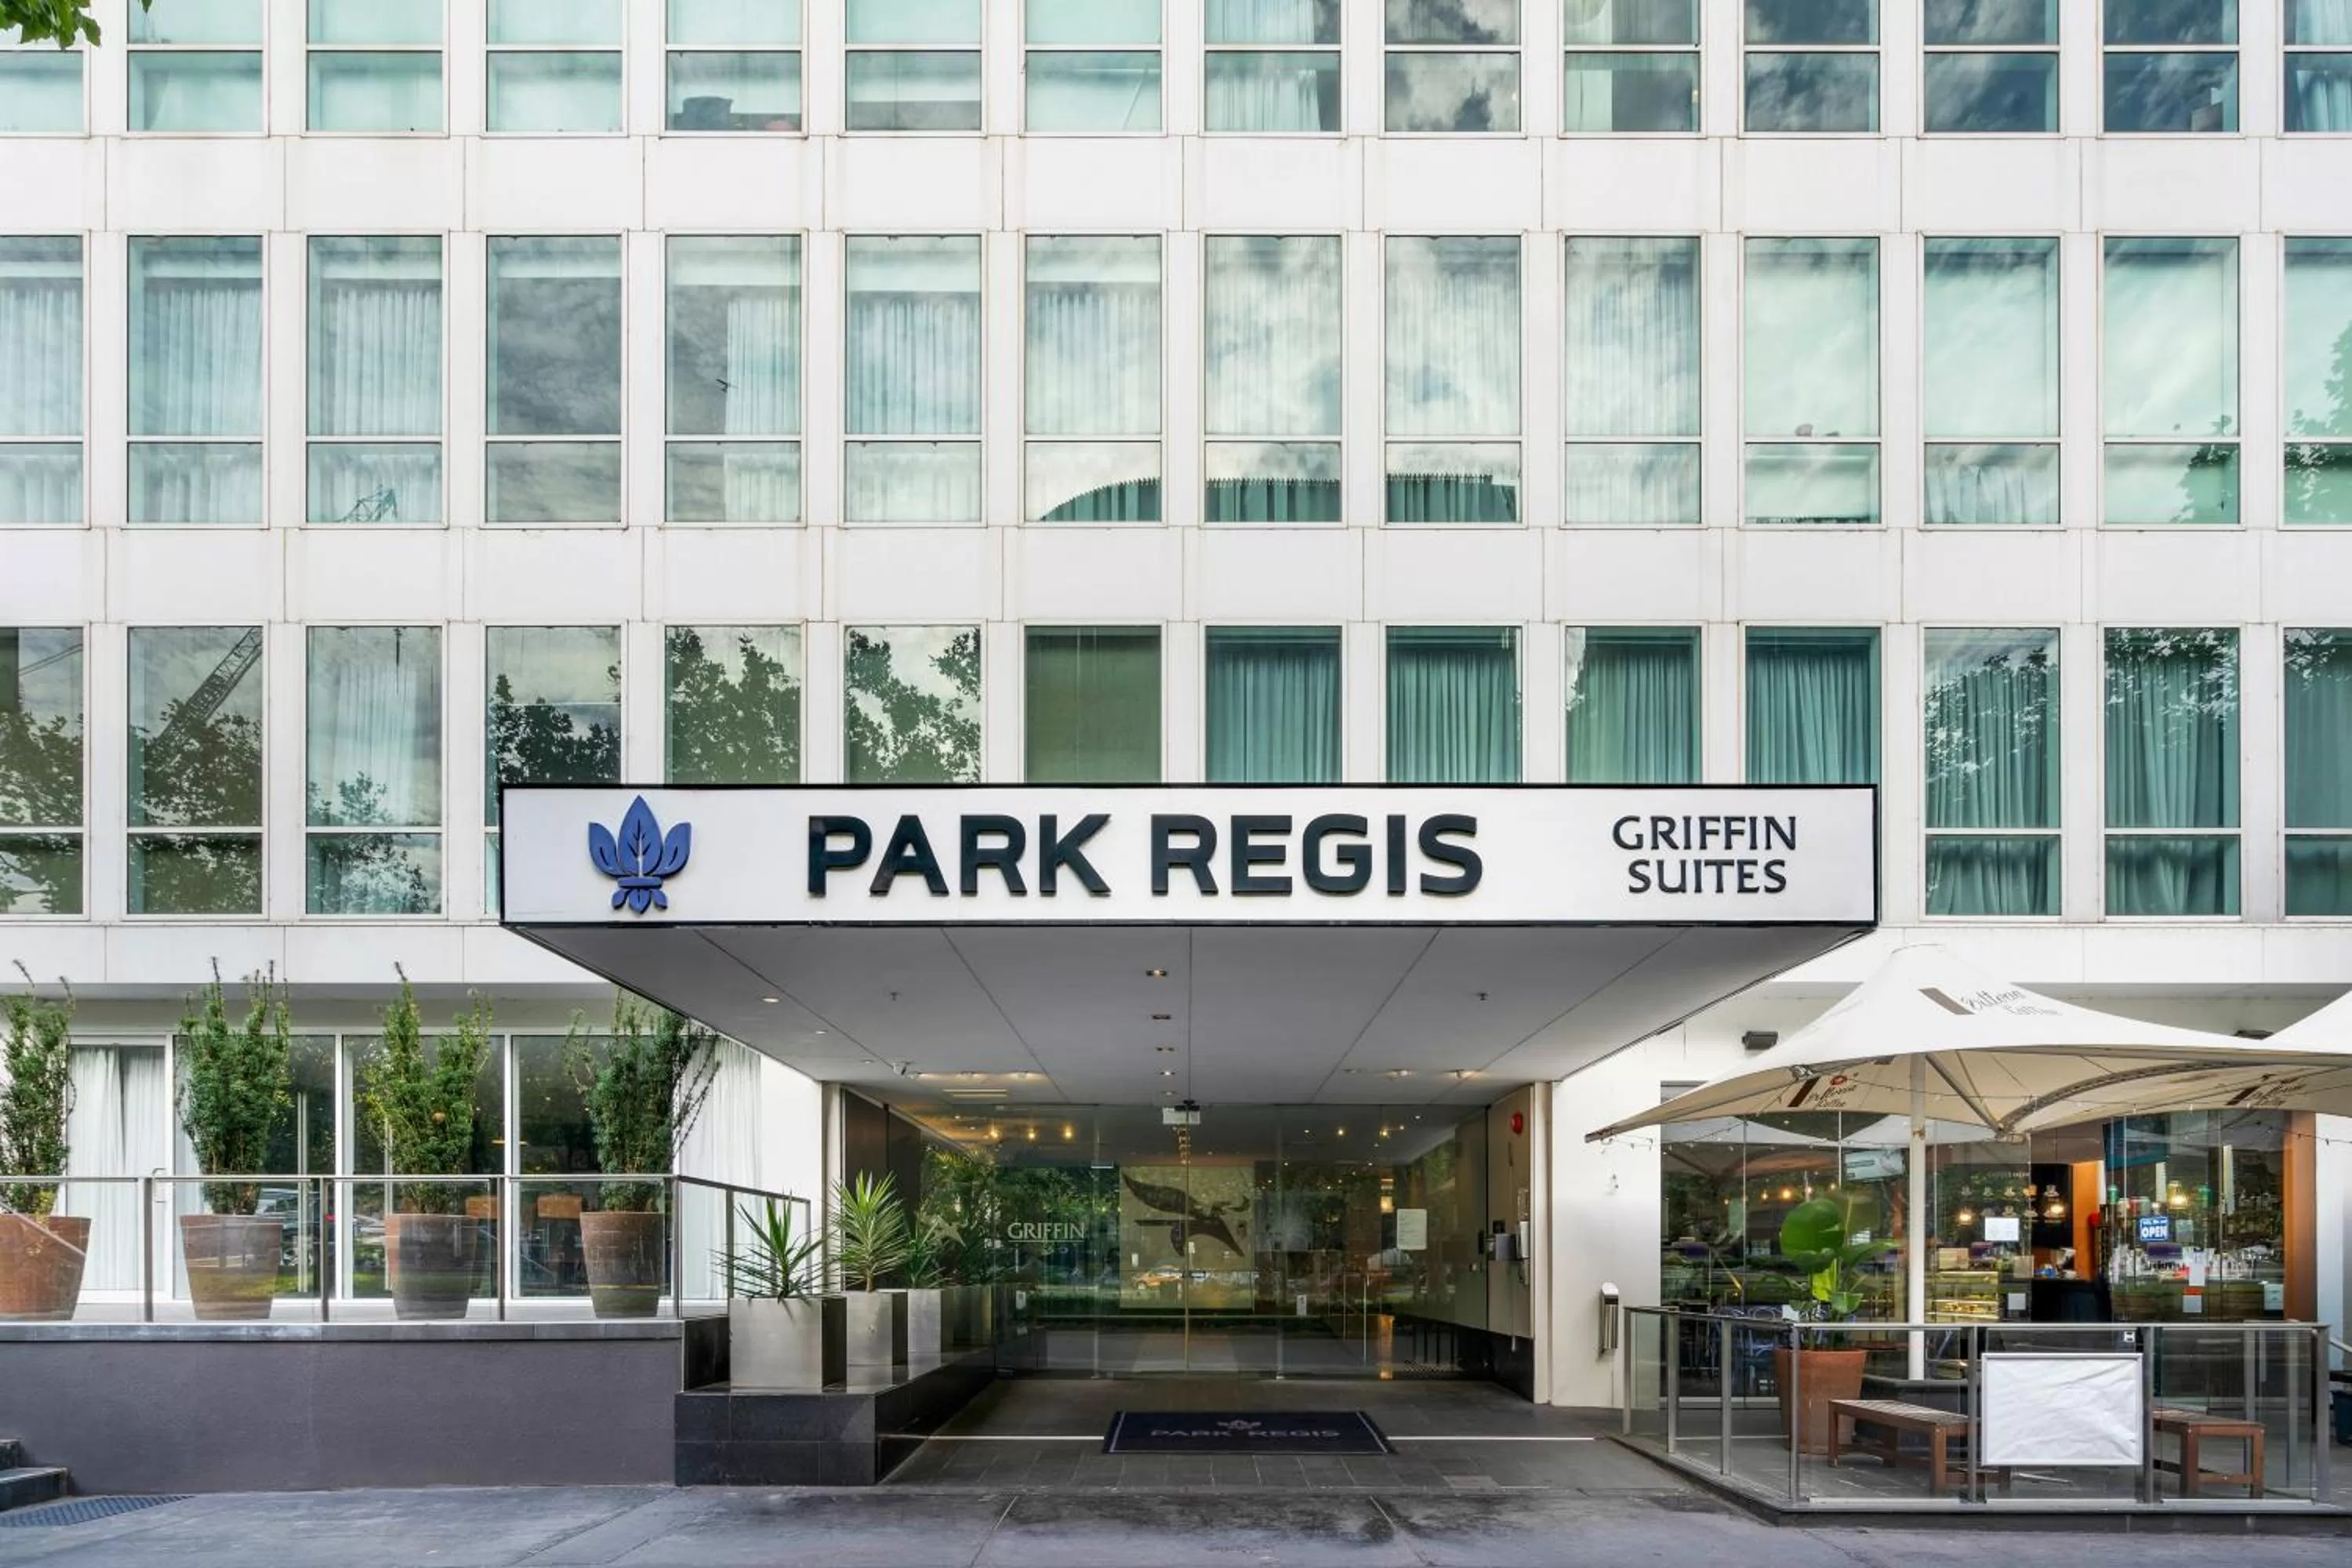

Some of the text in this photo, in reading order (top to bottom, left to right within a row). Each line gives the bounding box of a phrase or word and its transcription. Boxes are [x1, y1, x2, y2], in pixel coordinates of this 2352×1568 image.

[1613, 815, 1796, 851] GRIFFIN
[808, 812, 1483, 897] PARK REGIS
[1628, 858, 1787, 894] SUITES
[1007, 1222, 1085, 1240] GRIFFIN
[2141, 1225, 2168, 1238] OPEN
